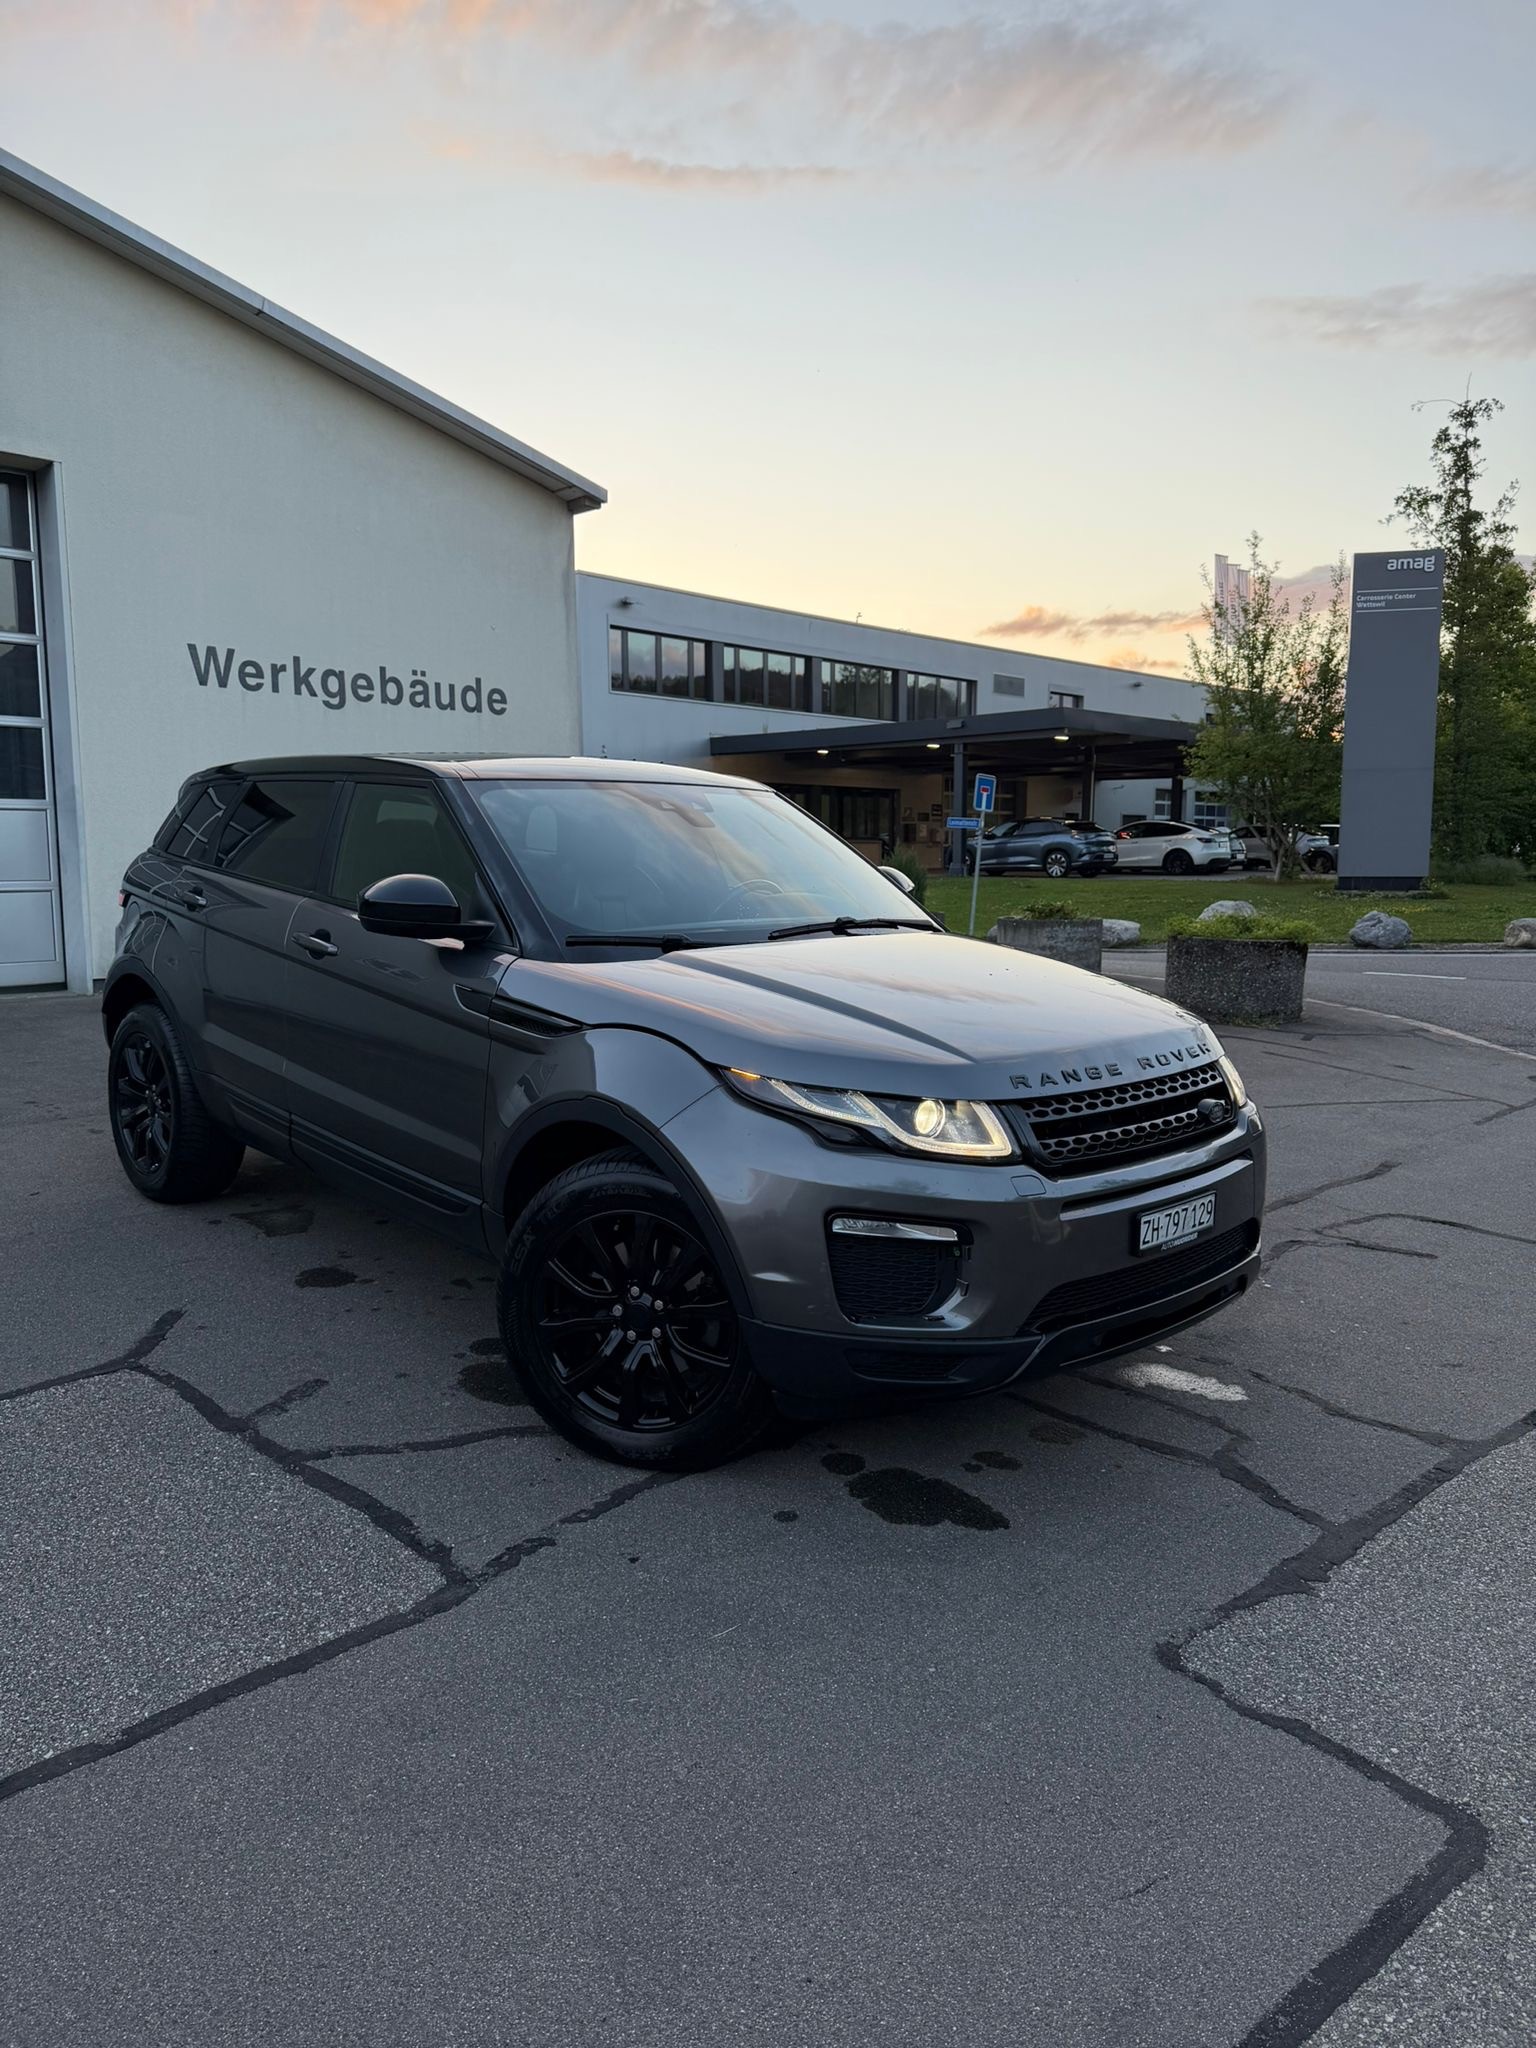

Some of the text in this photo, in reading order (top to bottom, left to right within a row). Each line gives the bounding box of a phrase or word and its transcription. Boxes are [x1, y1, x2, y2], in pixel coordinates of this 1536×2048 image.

[1387, 555, 1435, 572] amag
[1356, 594, 1393, 602] Carrosserie
[187, 643, 508, 716] Werkgebäude
[1009, 1043, 1212, 1090] RANGE ROVER
